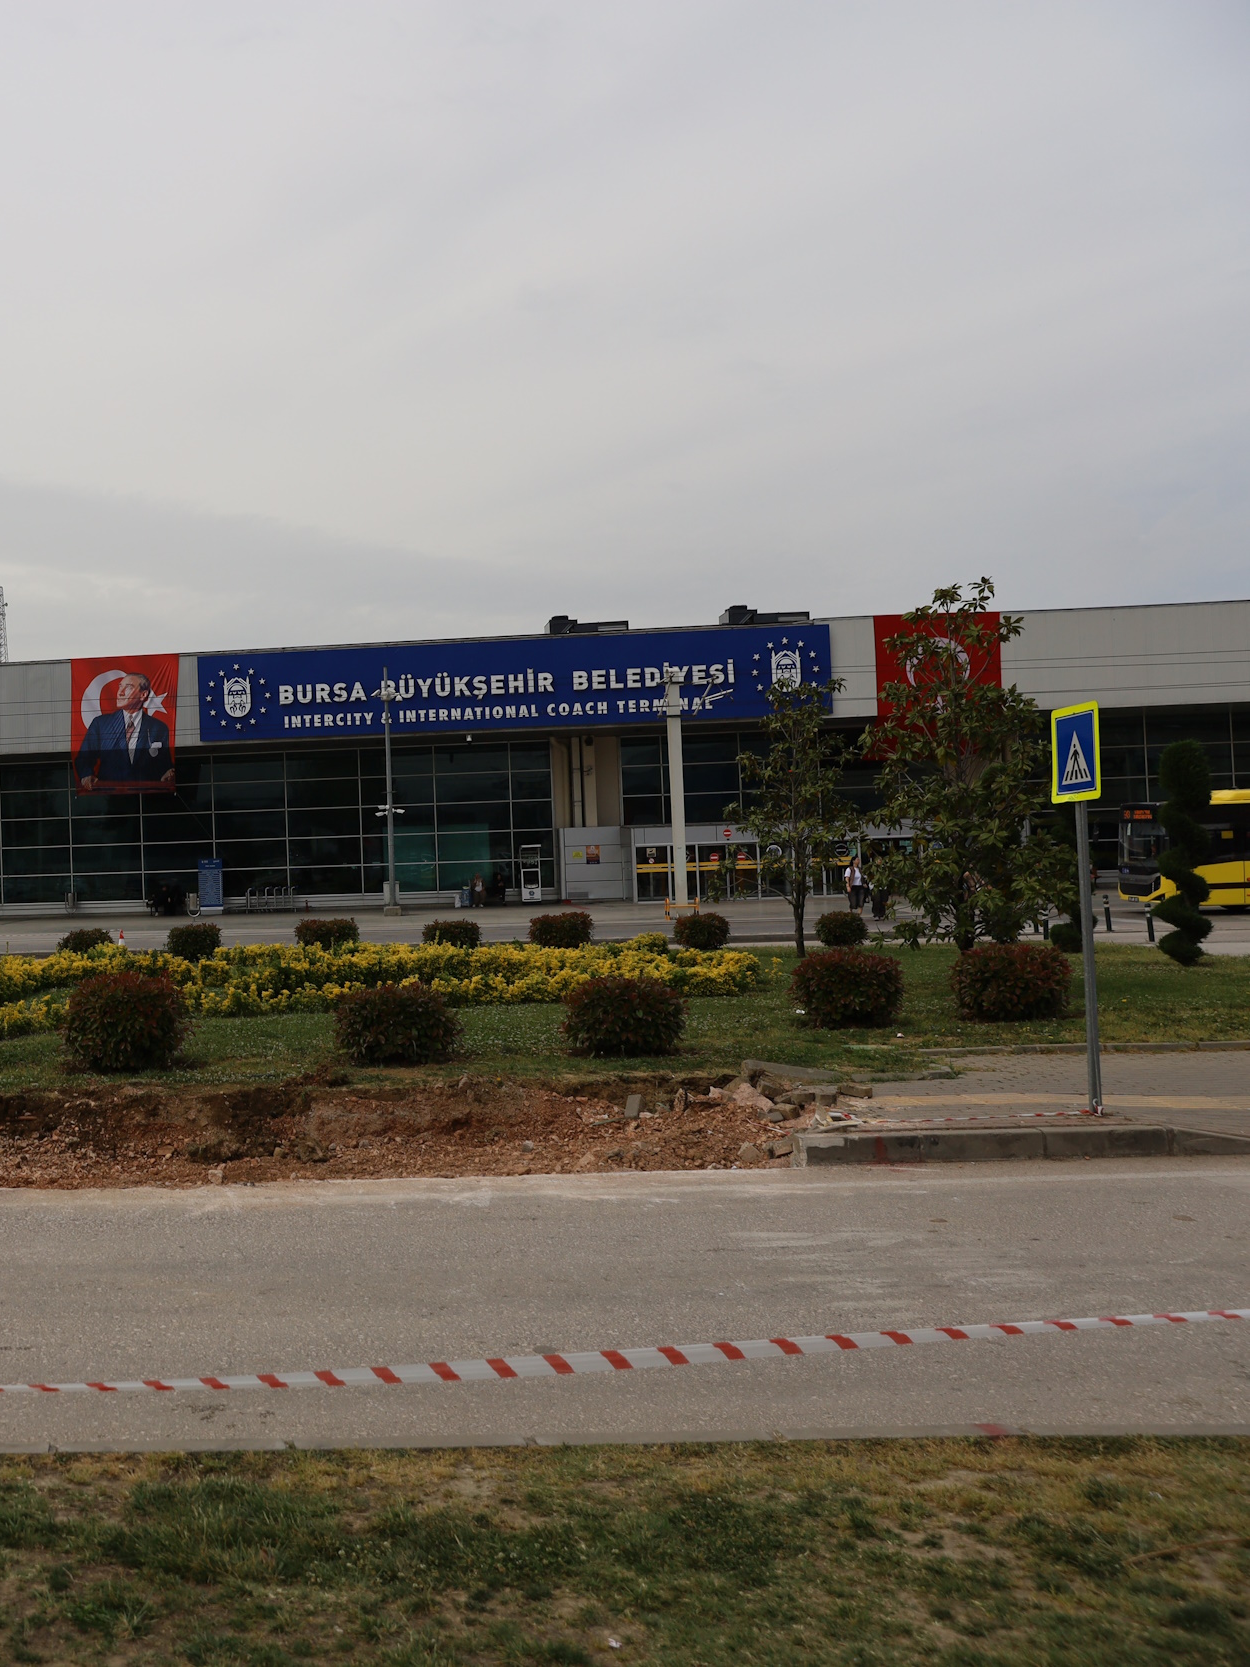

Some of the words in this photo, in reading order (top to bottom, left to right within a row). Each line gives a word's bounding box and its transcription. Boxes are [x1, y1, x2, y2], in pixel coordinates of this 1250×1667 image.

[279, 682, 367, 705] BURSA
[284, 711, 374, 728] INTERCITY
[399, 704, 539, 724] INTERNATIONAL
[547, 701, 608, 717] COACH
[617, 697, 713, 714] TERMNAL
